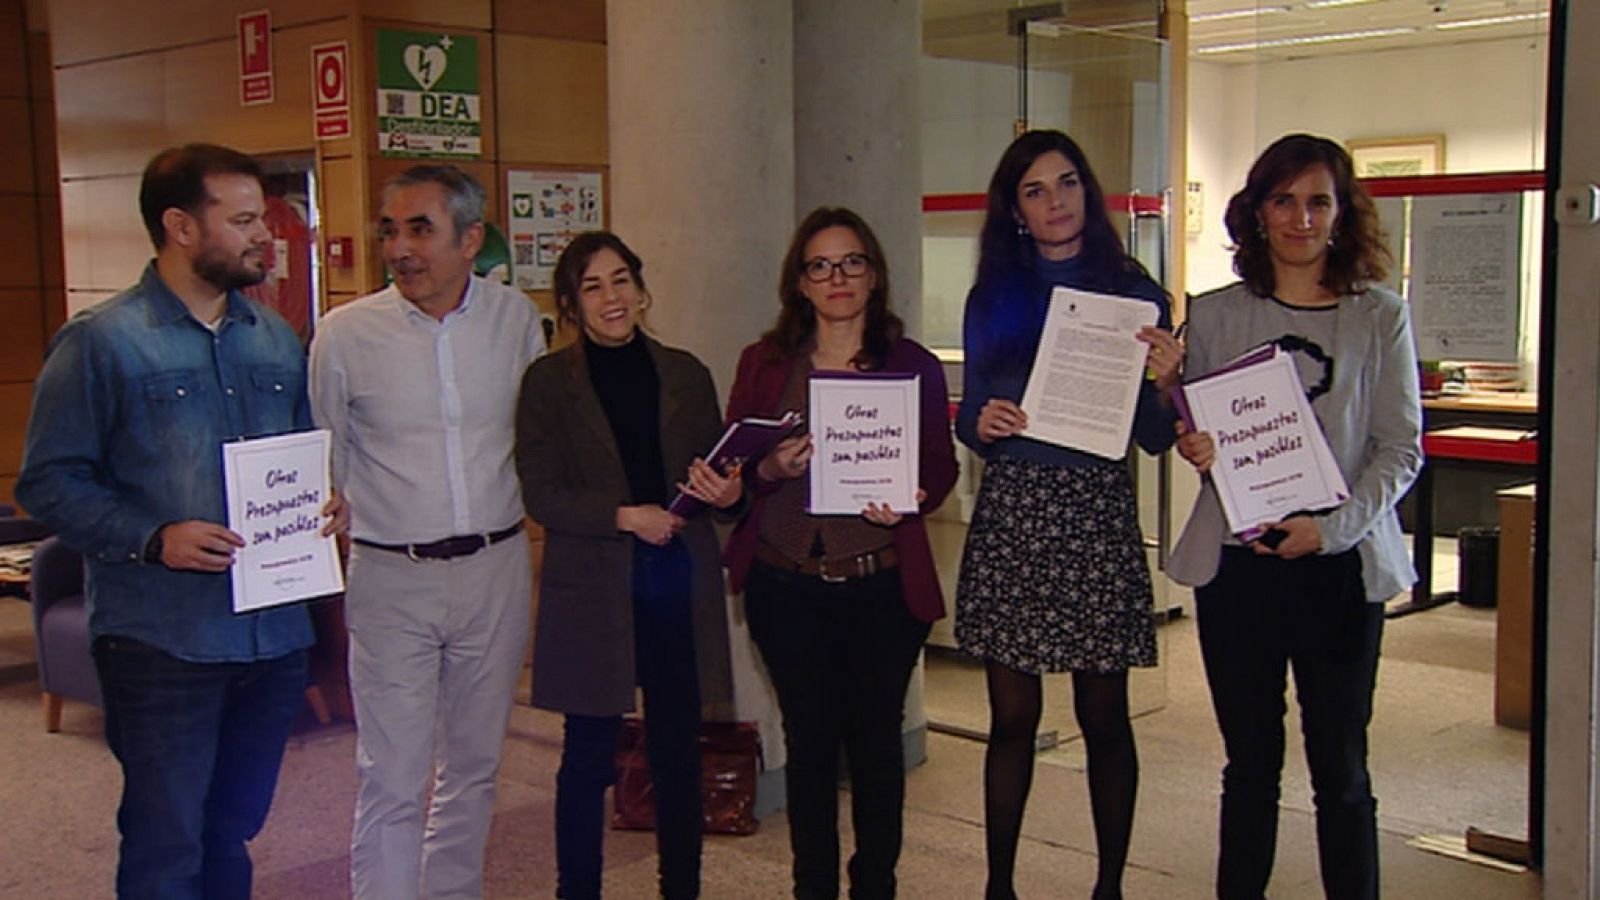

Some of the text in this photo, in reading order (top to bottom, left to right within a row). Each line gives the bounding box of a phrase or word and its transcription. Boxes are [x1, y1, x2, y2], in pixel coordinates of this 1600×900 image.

[420, 94, 471, 120] DEA
[1231, 395, 1266, 416] Otros
[825, 425, 903, 442] Presupuestos
[1217, 411, 1299, 449] Presupuestos
[854, 446, 901, 464] posibles
[1256, 435, 1304, 466] posibles
[245, 490, 320, 520] Presupuestos
[274, 514, 320, 542] posibles
